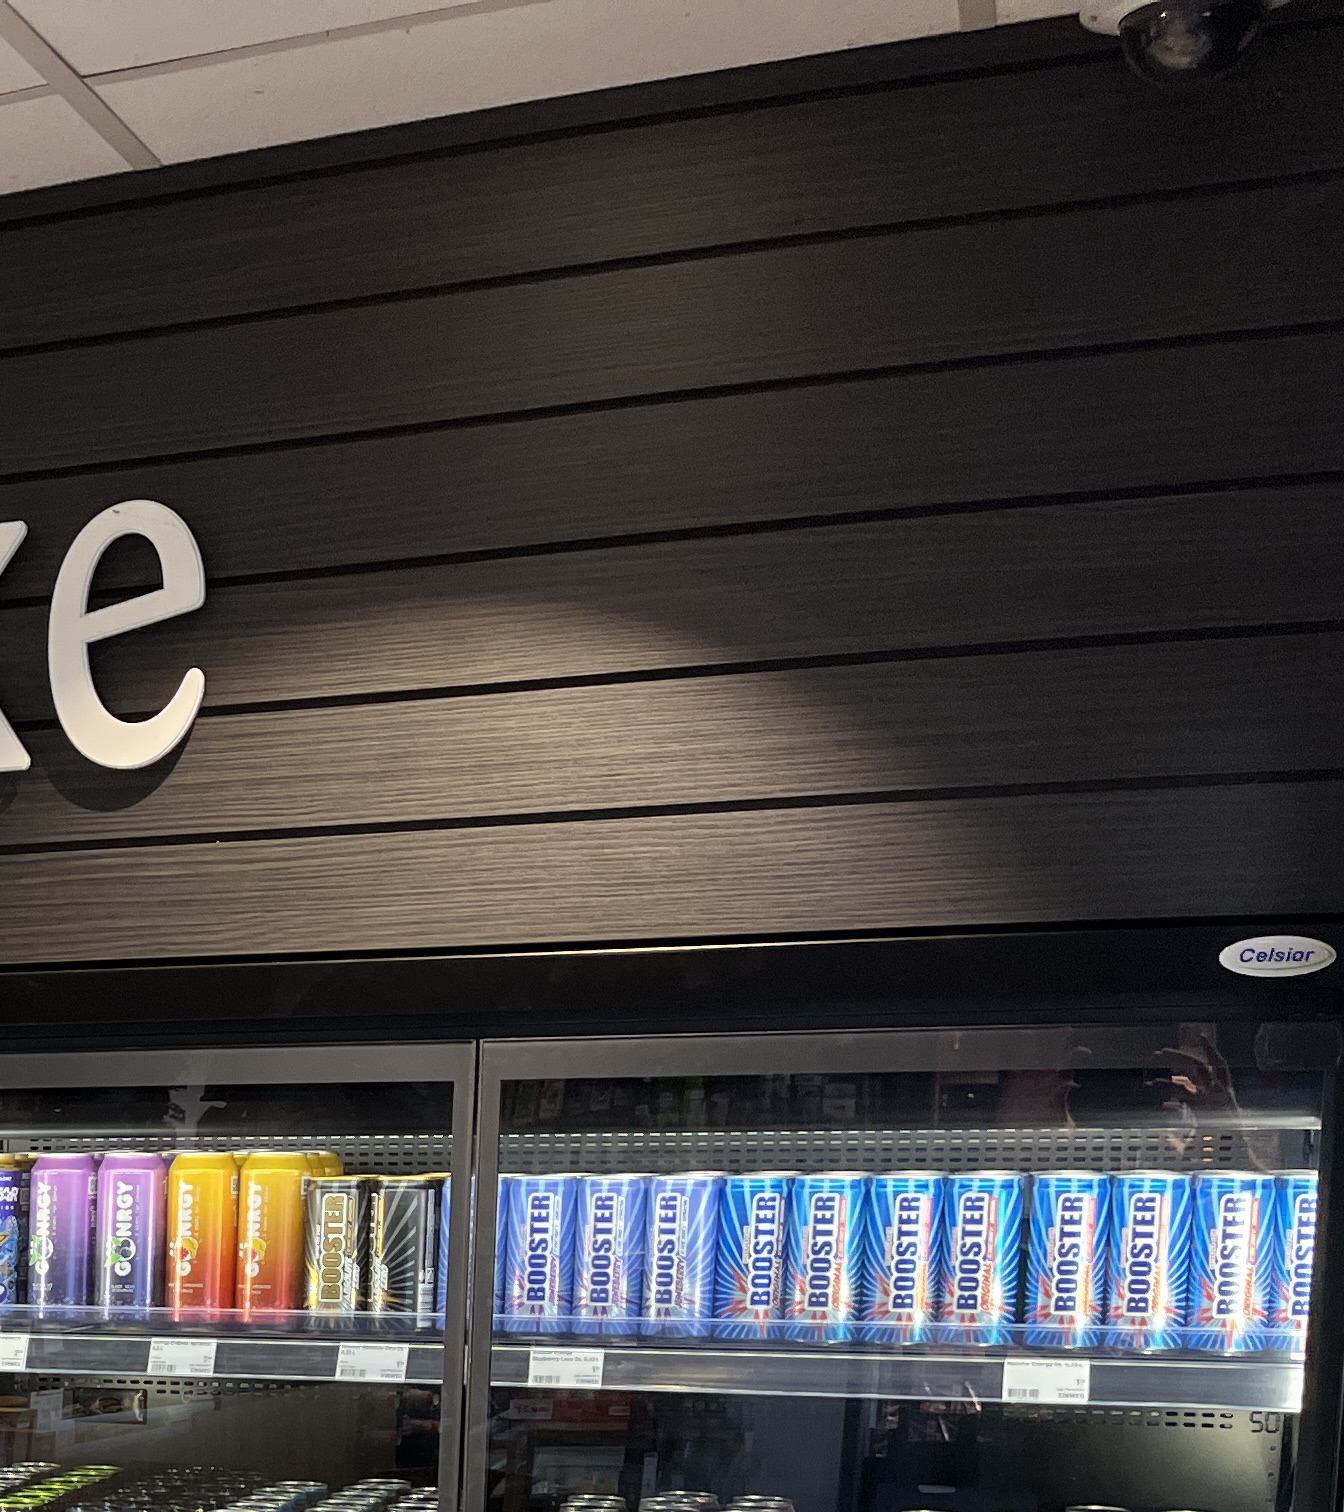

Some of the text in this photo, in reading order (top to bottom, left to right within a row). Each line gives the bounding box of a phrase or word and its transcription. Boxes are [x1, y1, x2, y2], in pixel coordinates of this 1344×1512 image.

[321, 1193, 347, 1301] BOOSTER
[526, 1192, 553, 1304] BOOSTER
[590, 1192, 618, 1305] BOOSTER
[655, 1192, 682, 1305] BOOSTER
[750, 1192, 780, 1308] BOOSTER
[808, 1192, 840, 1310] BOOSTER
[891, 1192, 924, 1312] BOOSTER
[955, 1192, 988, 1312] BOOSTER
[1053, 1192, 1088, 1314] BOOSTER
[1125, 1192, 1160, 1316] BOOSTER
[1215, 1192, 1252, 1319] BOOSTER
